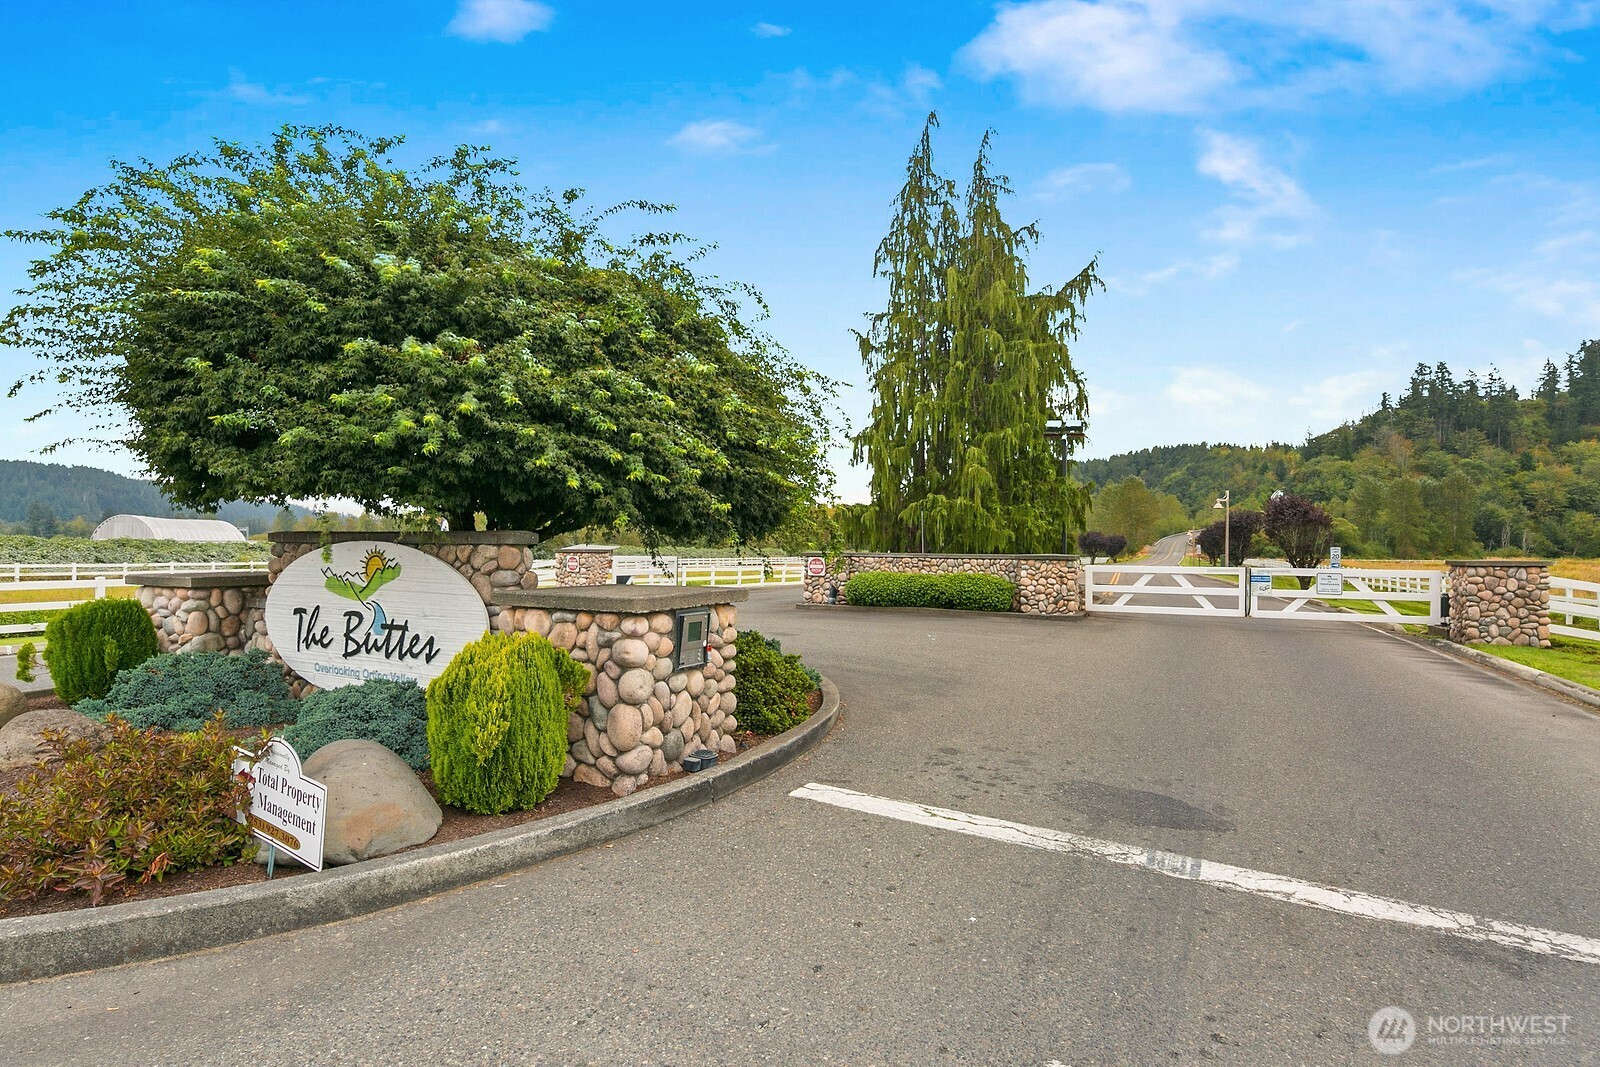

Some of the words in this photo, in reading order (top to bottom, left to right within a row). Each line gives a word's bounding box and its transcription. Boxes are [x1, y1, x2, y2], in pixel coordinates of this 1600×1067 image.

[293, 604, 334, 652] The
[342, 610, 441, 664] Buttes
[314, 662, 360, 680] Overlooking
[257, 766, 279, 791] Total
[281, 777, 322, 814] Property
[257, 792, 316, 836] Management
